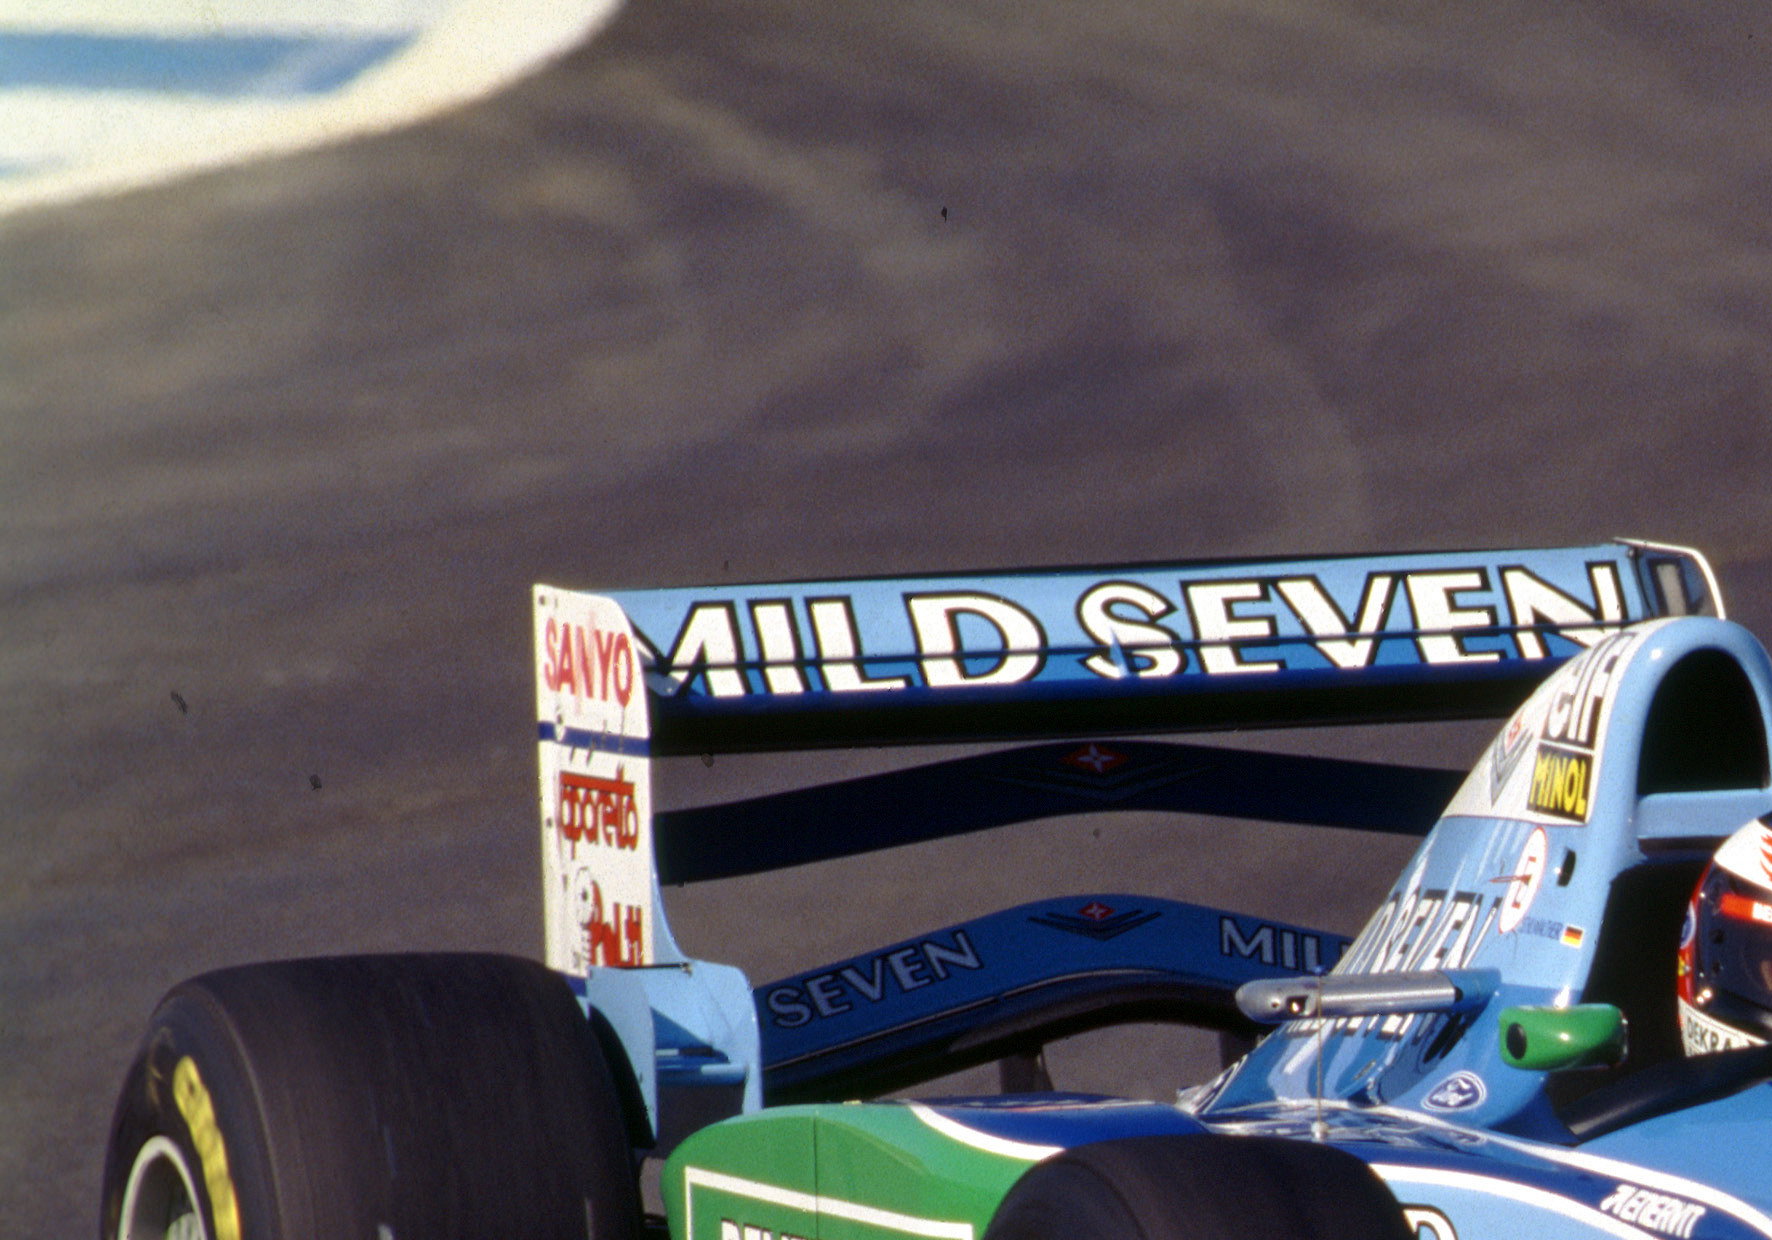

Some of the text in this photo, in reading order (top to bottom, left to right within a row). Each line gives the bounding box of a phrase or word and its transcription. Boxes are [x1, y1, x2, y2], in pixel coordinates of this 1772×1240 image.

[545, 617, 634, 707] SANYO
[633, 559, 1628, 698] MILD SEVEN
[1529, 752, 1588, 817] MINOL
[766, 929, 983, 1029] SEVEN
[1218, 916, 1350, 975] MIL
[1686, 1015, 1732, 1051] DEKRA
